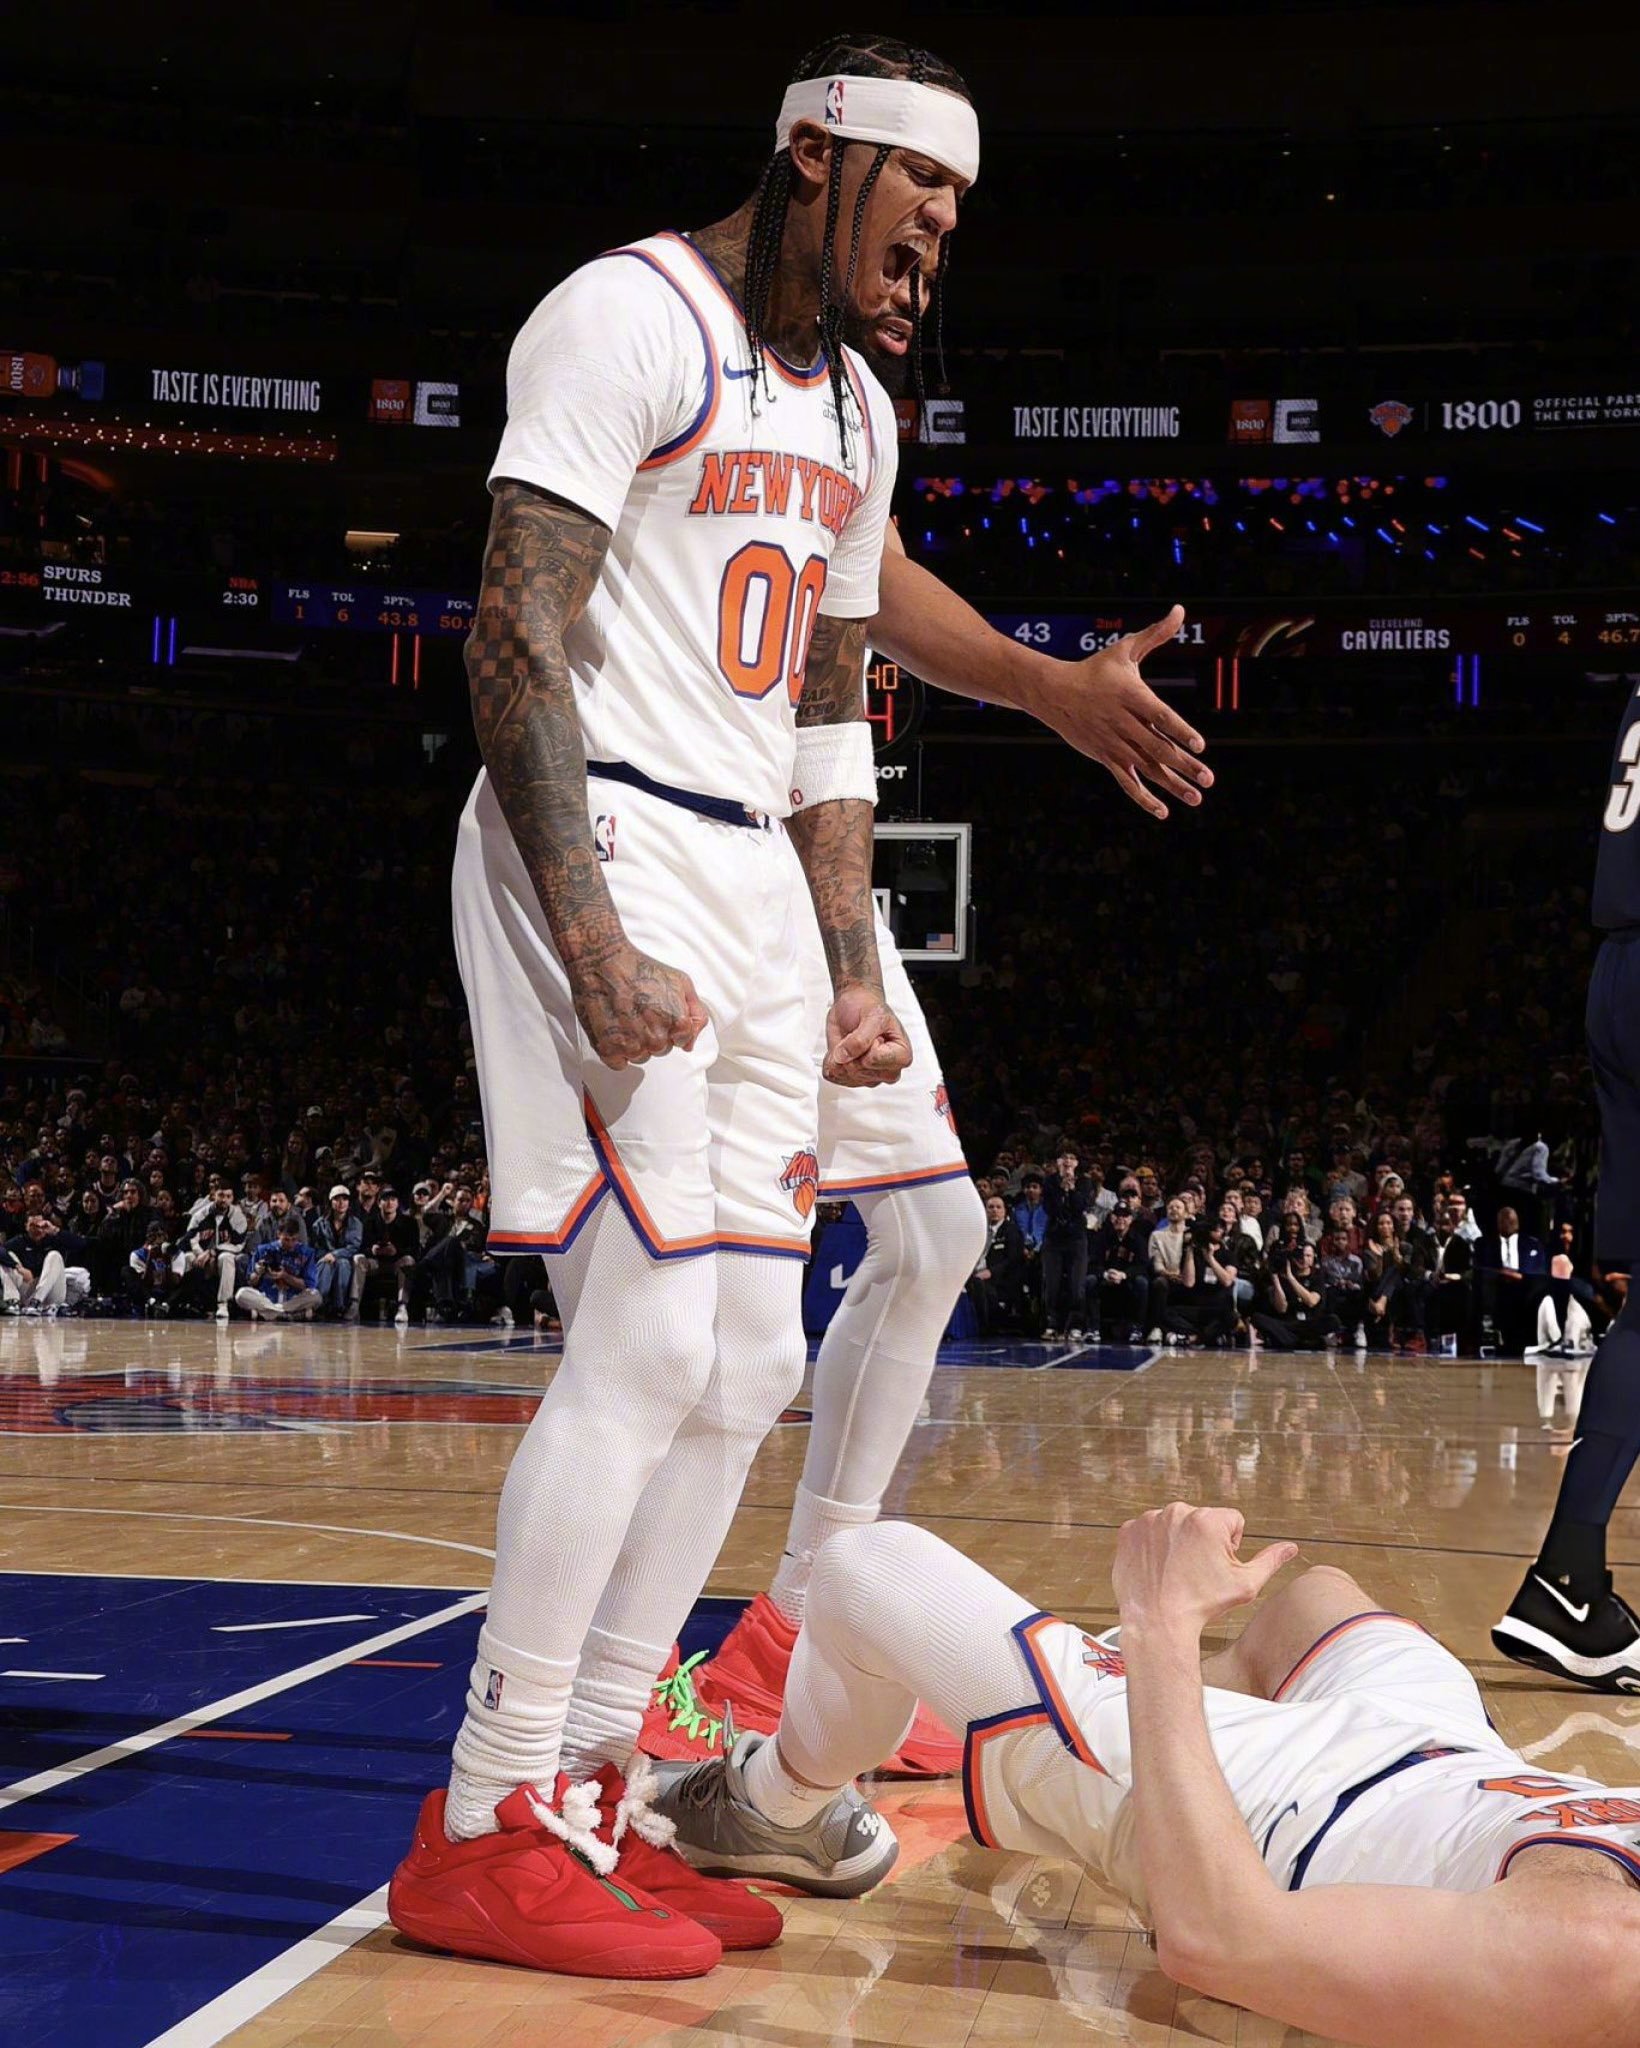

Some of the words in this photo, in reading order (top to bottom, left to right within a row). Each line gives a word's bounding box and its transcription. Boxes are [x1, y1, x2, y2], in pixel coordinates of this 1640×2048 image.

[152, 369, 199, 403] TASTE
[203, 373, 219, 405] IS
[222, 375, 321, 412] EVERYTHING
[1533, 396, 1601, 408] OFFICIAL
[1013, 406, 1059, 437] TASTE
[1063, 406, 1079, 437] IS
[1082, 406, 1179, 437] EVERYTHING
[1441, 400, 1521, 430] 1800
[1534, 410, 1561, 422] THE
[1567, 409, 1598, 420] NEW
[1603, 407, 1640, 418] YORK
[688, 450, 794, 516] NEW
[43, 565, 102, 583] SPURS
[43, 586, 131, 607] THUNDER
[223, 591, 258, 605] 2:30
[288, 588, 310, 599] FLS
[331, 592, 354, 603] TOL
[383, 595, 415, 607] 3PT%
[447, 600, 472, 610] FG%
[296, 605, 304, 619] 1
[337, 608, 348, 622] 6
[378, 612, 419, 626] 43.8
[717, 540, 828, 709] 00
[1507, 616, 1529, 626] FLS
[1553, 615, 1577, 625] TOL
[1014, 622, 1051, 642] 43
[1080, 632, 1121, 651] 6:4
[1342, 629, 1450, 650] CAVALIERS
[1513, 632, 1526, 646] 0
[1557, 631, 1571, 645] 4
[1598, 629, 1640, 644] 46.7
